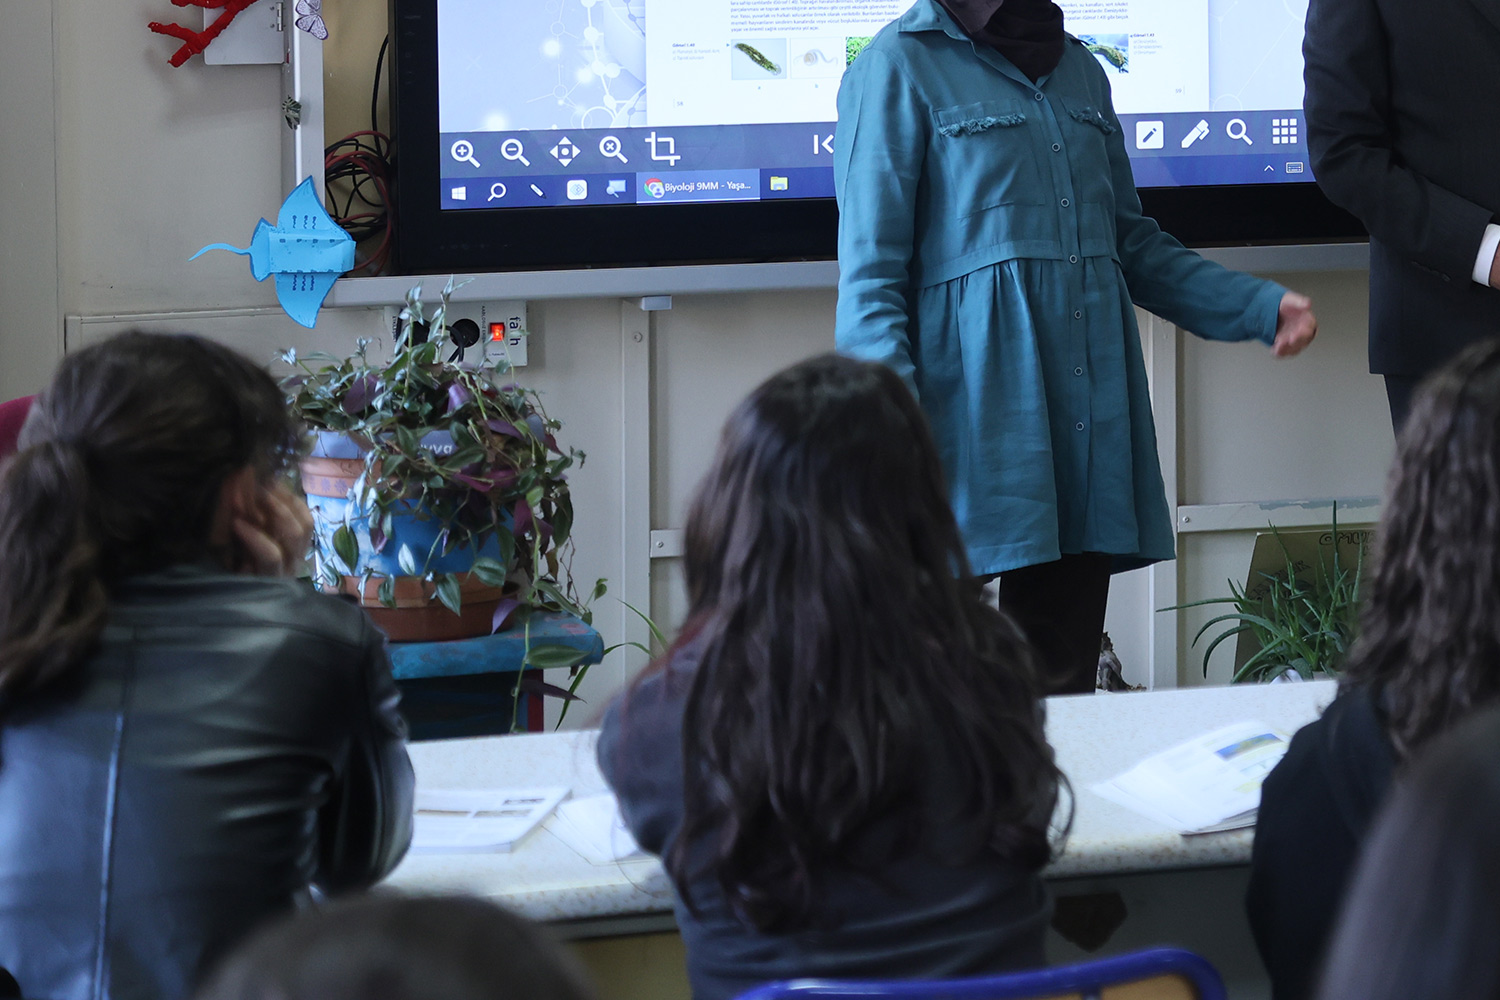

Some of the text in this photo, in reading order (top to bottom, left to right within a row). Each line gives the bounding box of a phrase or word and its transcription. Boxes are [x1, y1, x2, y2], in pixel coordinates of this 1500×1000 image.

[664, 181, 695, 194] Biyoloji
[696, 181, 719, 191] 9MM
[509, 316, 521, 346] fah
